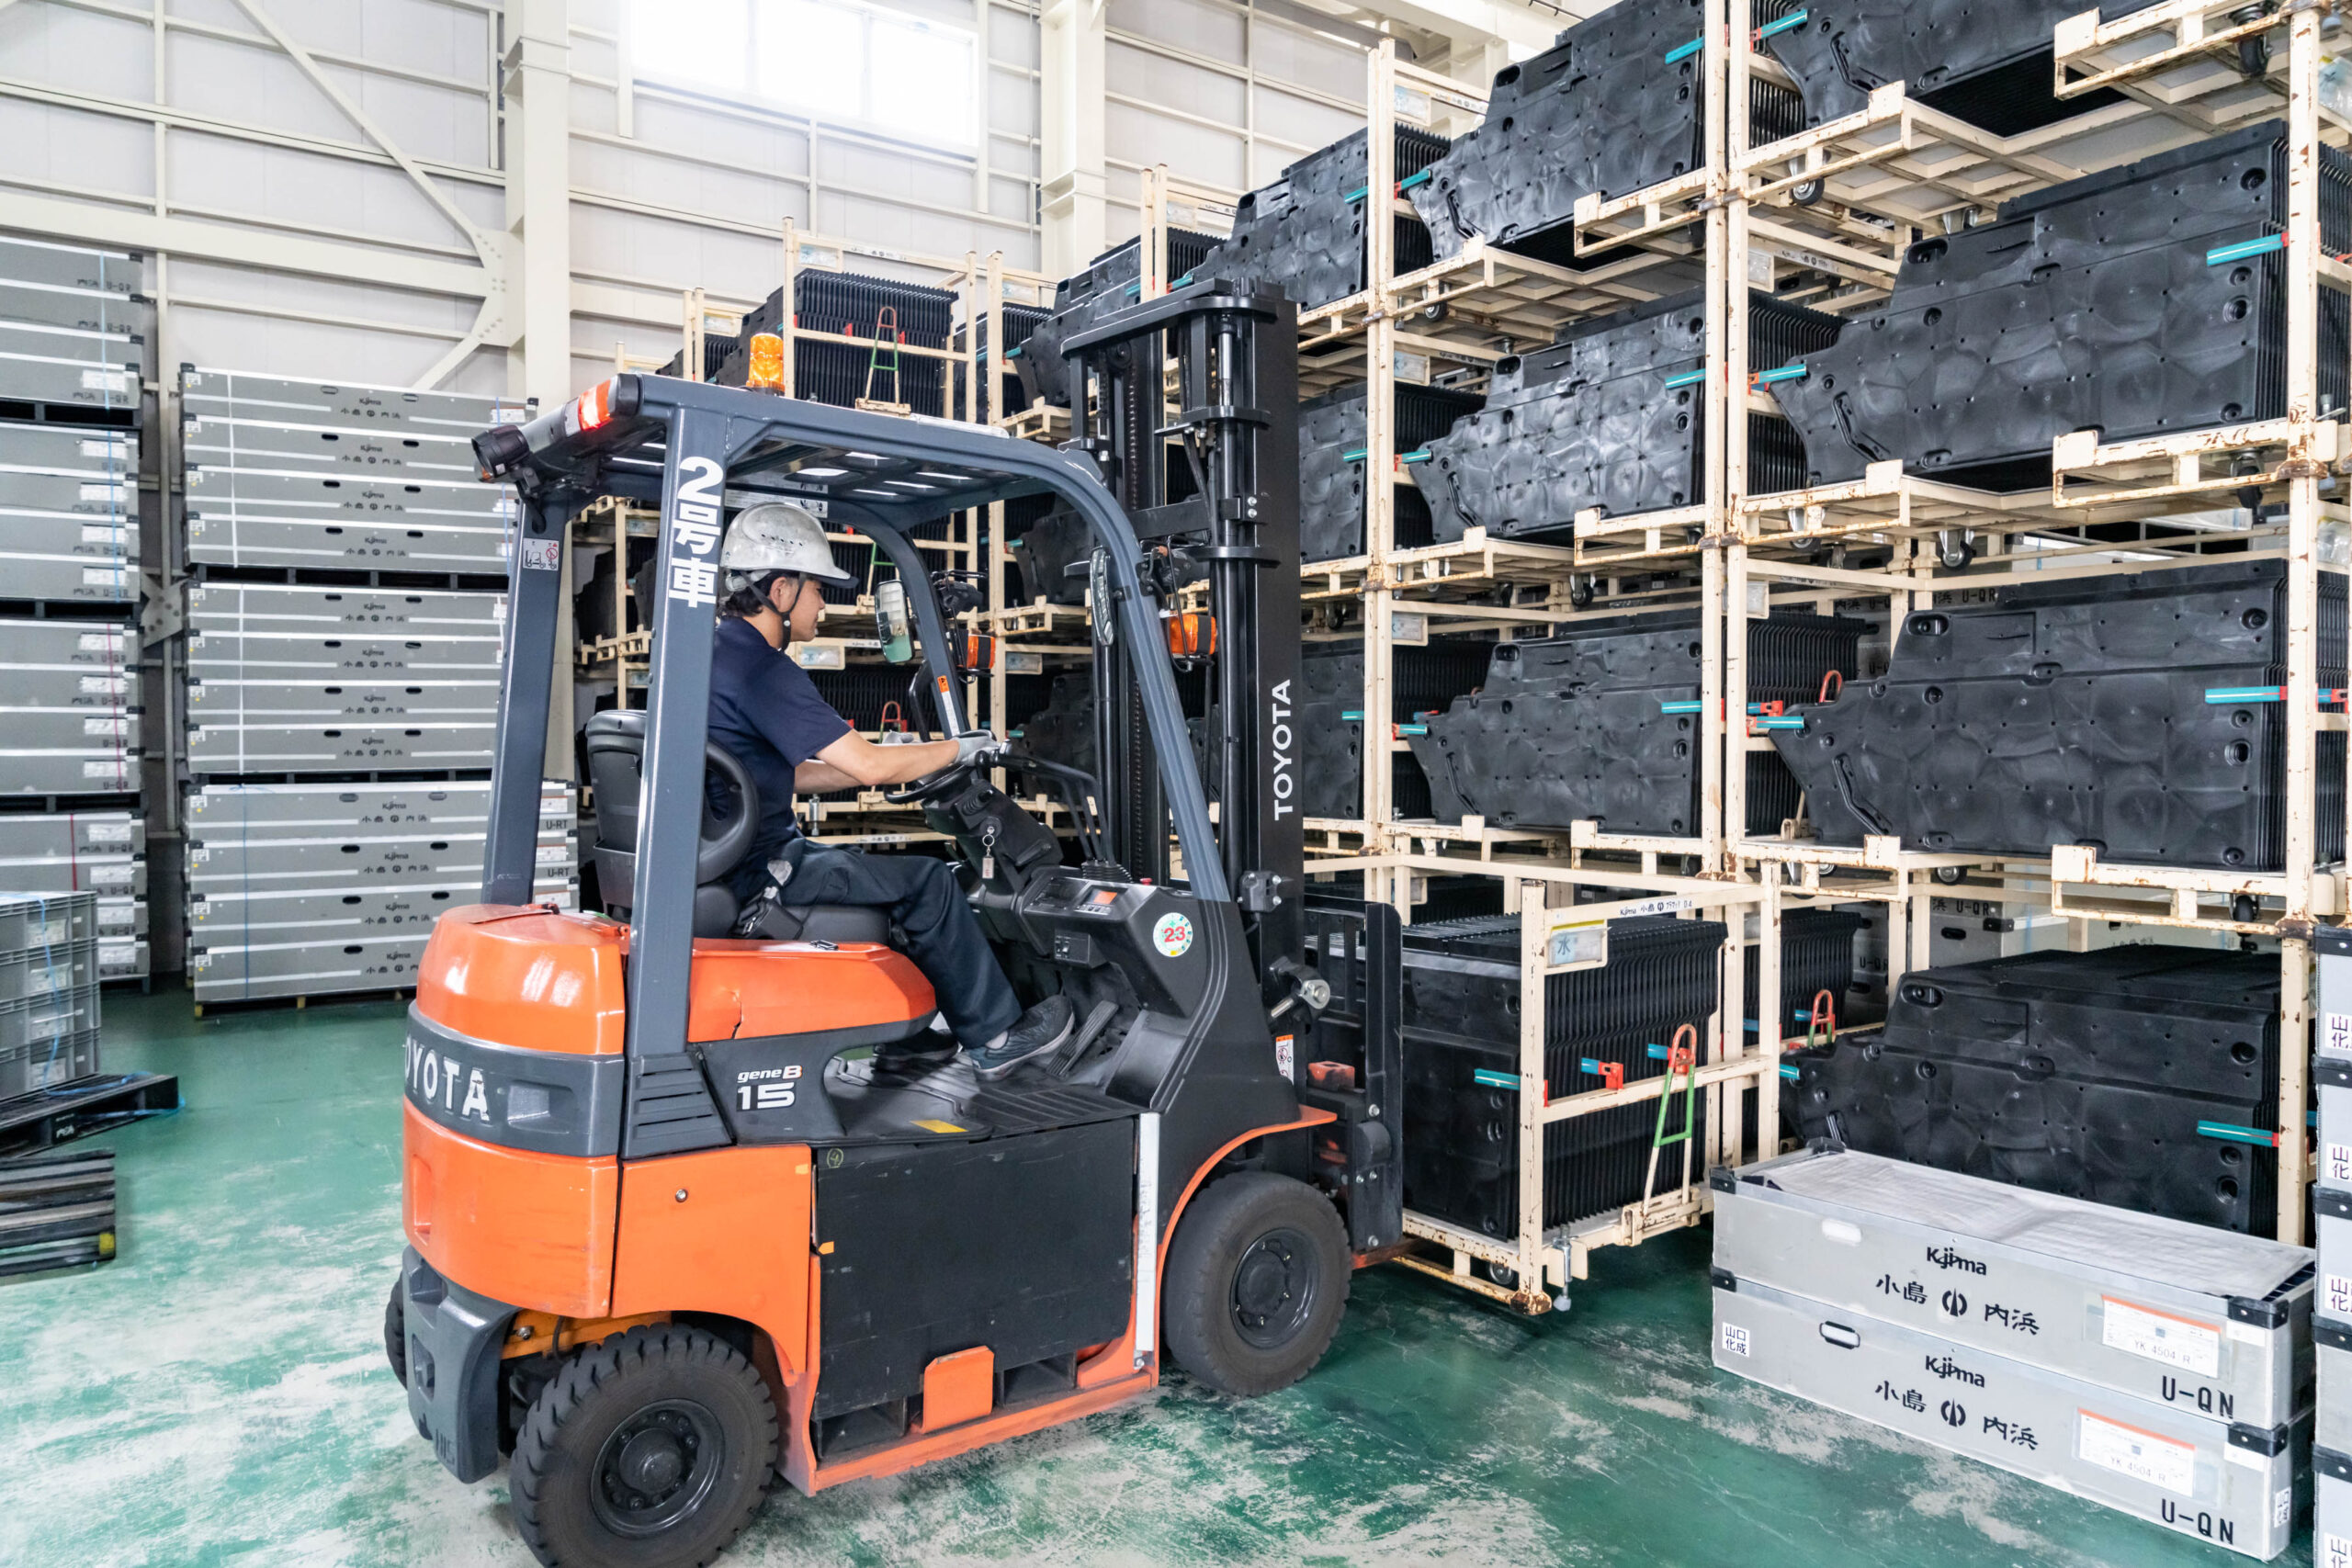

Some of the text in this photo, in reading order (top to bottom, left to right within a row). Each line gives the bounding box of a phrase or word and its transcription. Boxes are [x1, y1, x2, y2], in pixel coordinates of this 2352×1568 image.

[669, 457, 724, 608] 2号車
[1272, 679, 1294, 821] TOYOTA
[546, 819, 569, 829] U-RT
[548, 867, 570, 877] U-RT
[1956, 900, 1990, 916] U-QR
[1163, 926, 1186, 943] 23
[2332, 1015, 2352, 1032] 山
[738, 1082, 796, 1111] 15
[1876, 1274, 2040, 1335] 小島 内浜
[1725, 1325, 1747, 1341] 山口
[2151, 1343, 2177, 1360] 4504
[2162, 1375, 2233, 1419] U-QN
[1875, 1381, 2039, 1450] 小島 内浜
[2127, 1461, 2152, 1478] 4504
[2162, 1498, 2233, 1545] U-QN
